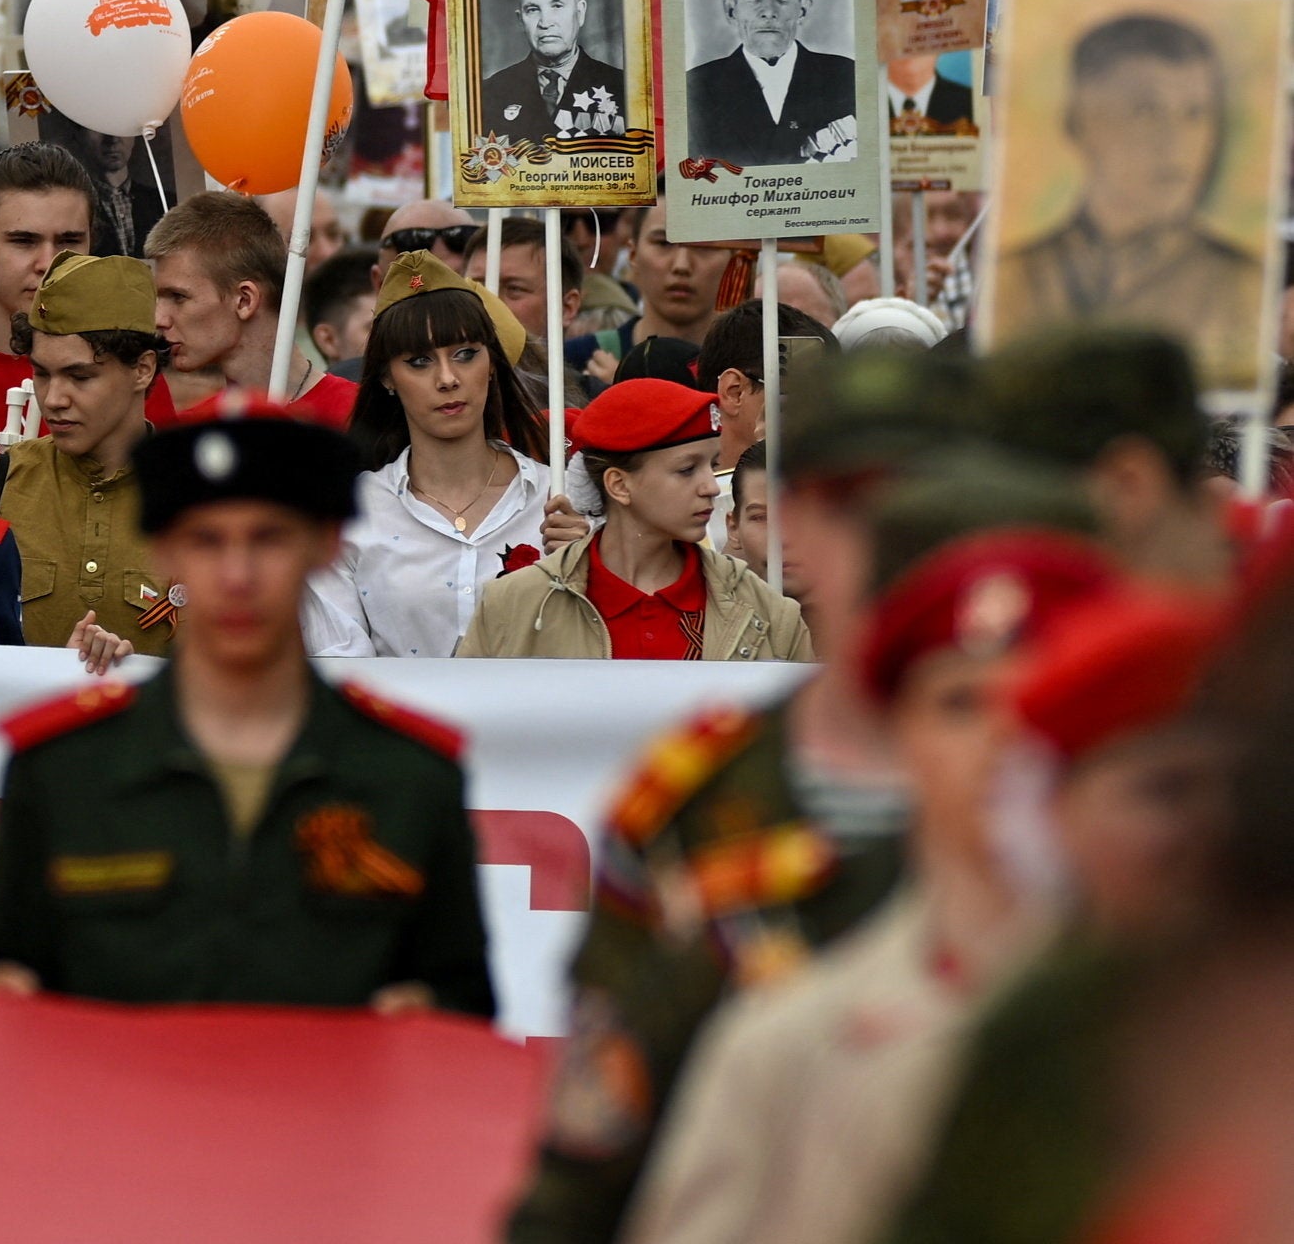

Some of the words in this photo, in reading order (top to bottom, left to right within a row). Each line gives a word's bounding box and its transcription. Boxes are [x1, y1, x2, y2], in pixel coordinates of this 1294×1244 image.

[570, 156, 635, 168] МОИСЕЕВ
[519, 170, 569, 185] Георгий
[573, 169, 635, 182] Иванович
[743, 176, 803, 190] Токарев
[691, 191, 759, 206] Никифор
[763, 188, 856, 203] Михайлович
[746, 206, 801, 219] сержант
[784, 217, 847, 229] Бессмертный
[848, 217, 870, 226] полк
